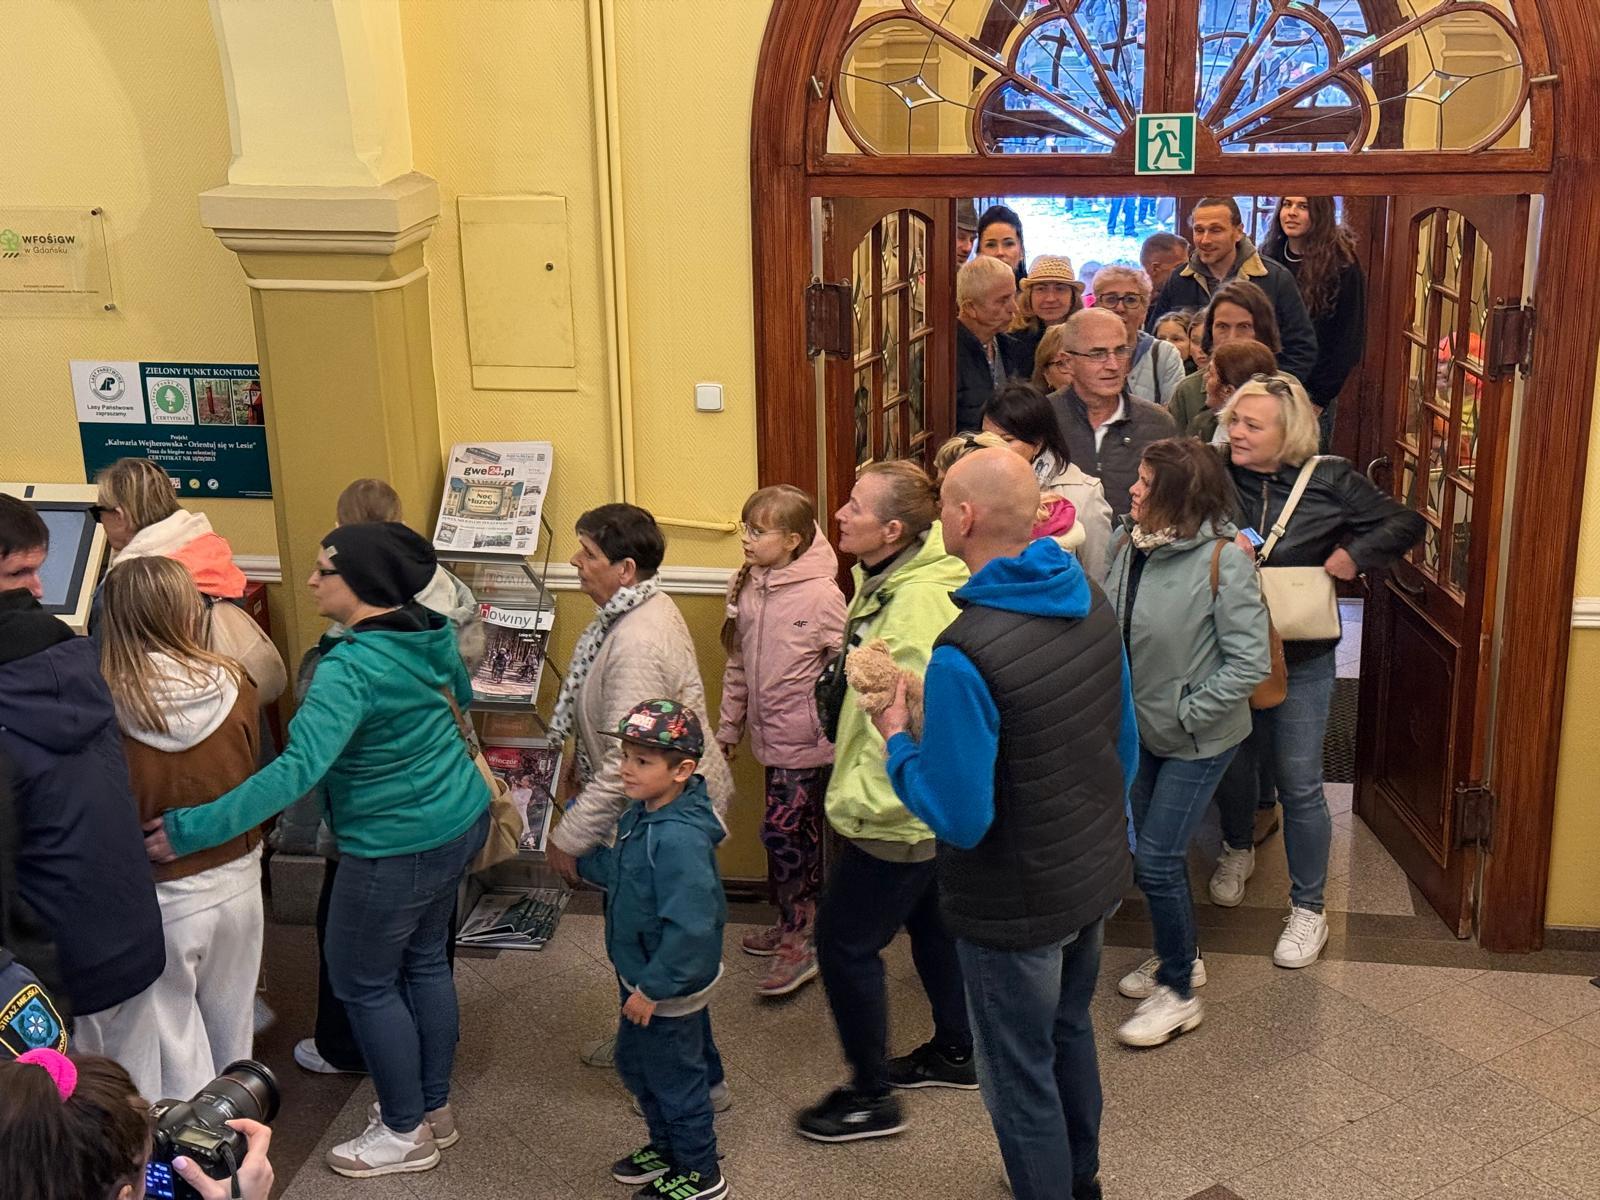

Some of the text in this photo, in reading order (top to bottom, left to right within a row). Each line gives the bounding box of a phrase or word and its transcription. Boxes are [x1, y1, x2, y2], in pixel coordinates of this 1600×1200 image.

[22, 233, 75, 244] WFOŚiGW
[33, 246, 68, 254] Gdańsku
[145, 367, 181, 375] ZIELONY
[183, 368, 211, 376] PUNKT
[138, 440, 183, 448] Wejherowska
[188, 441, 216, 449] Orientuj
[464, 466, 515, 477] gwe24.pl
[481, 607, 531, 628] nowiny
[793, 620, 808, 628] 4F
